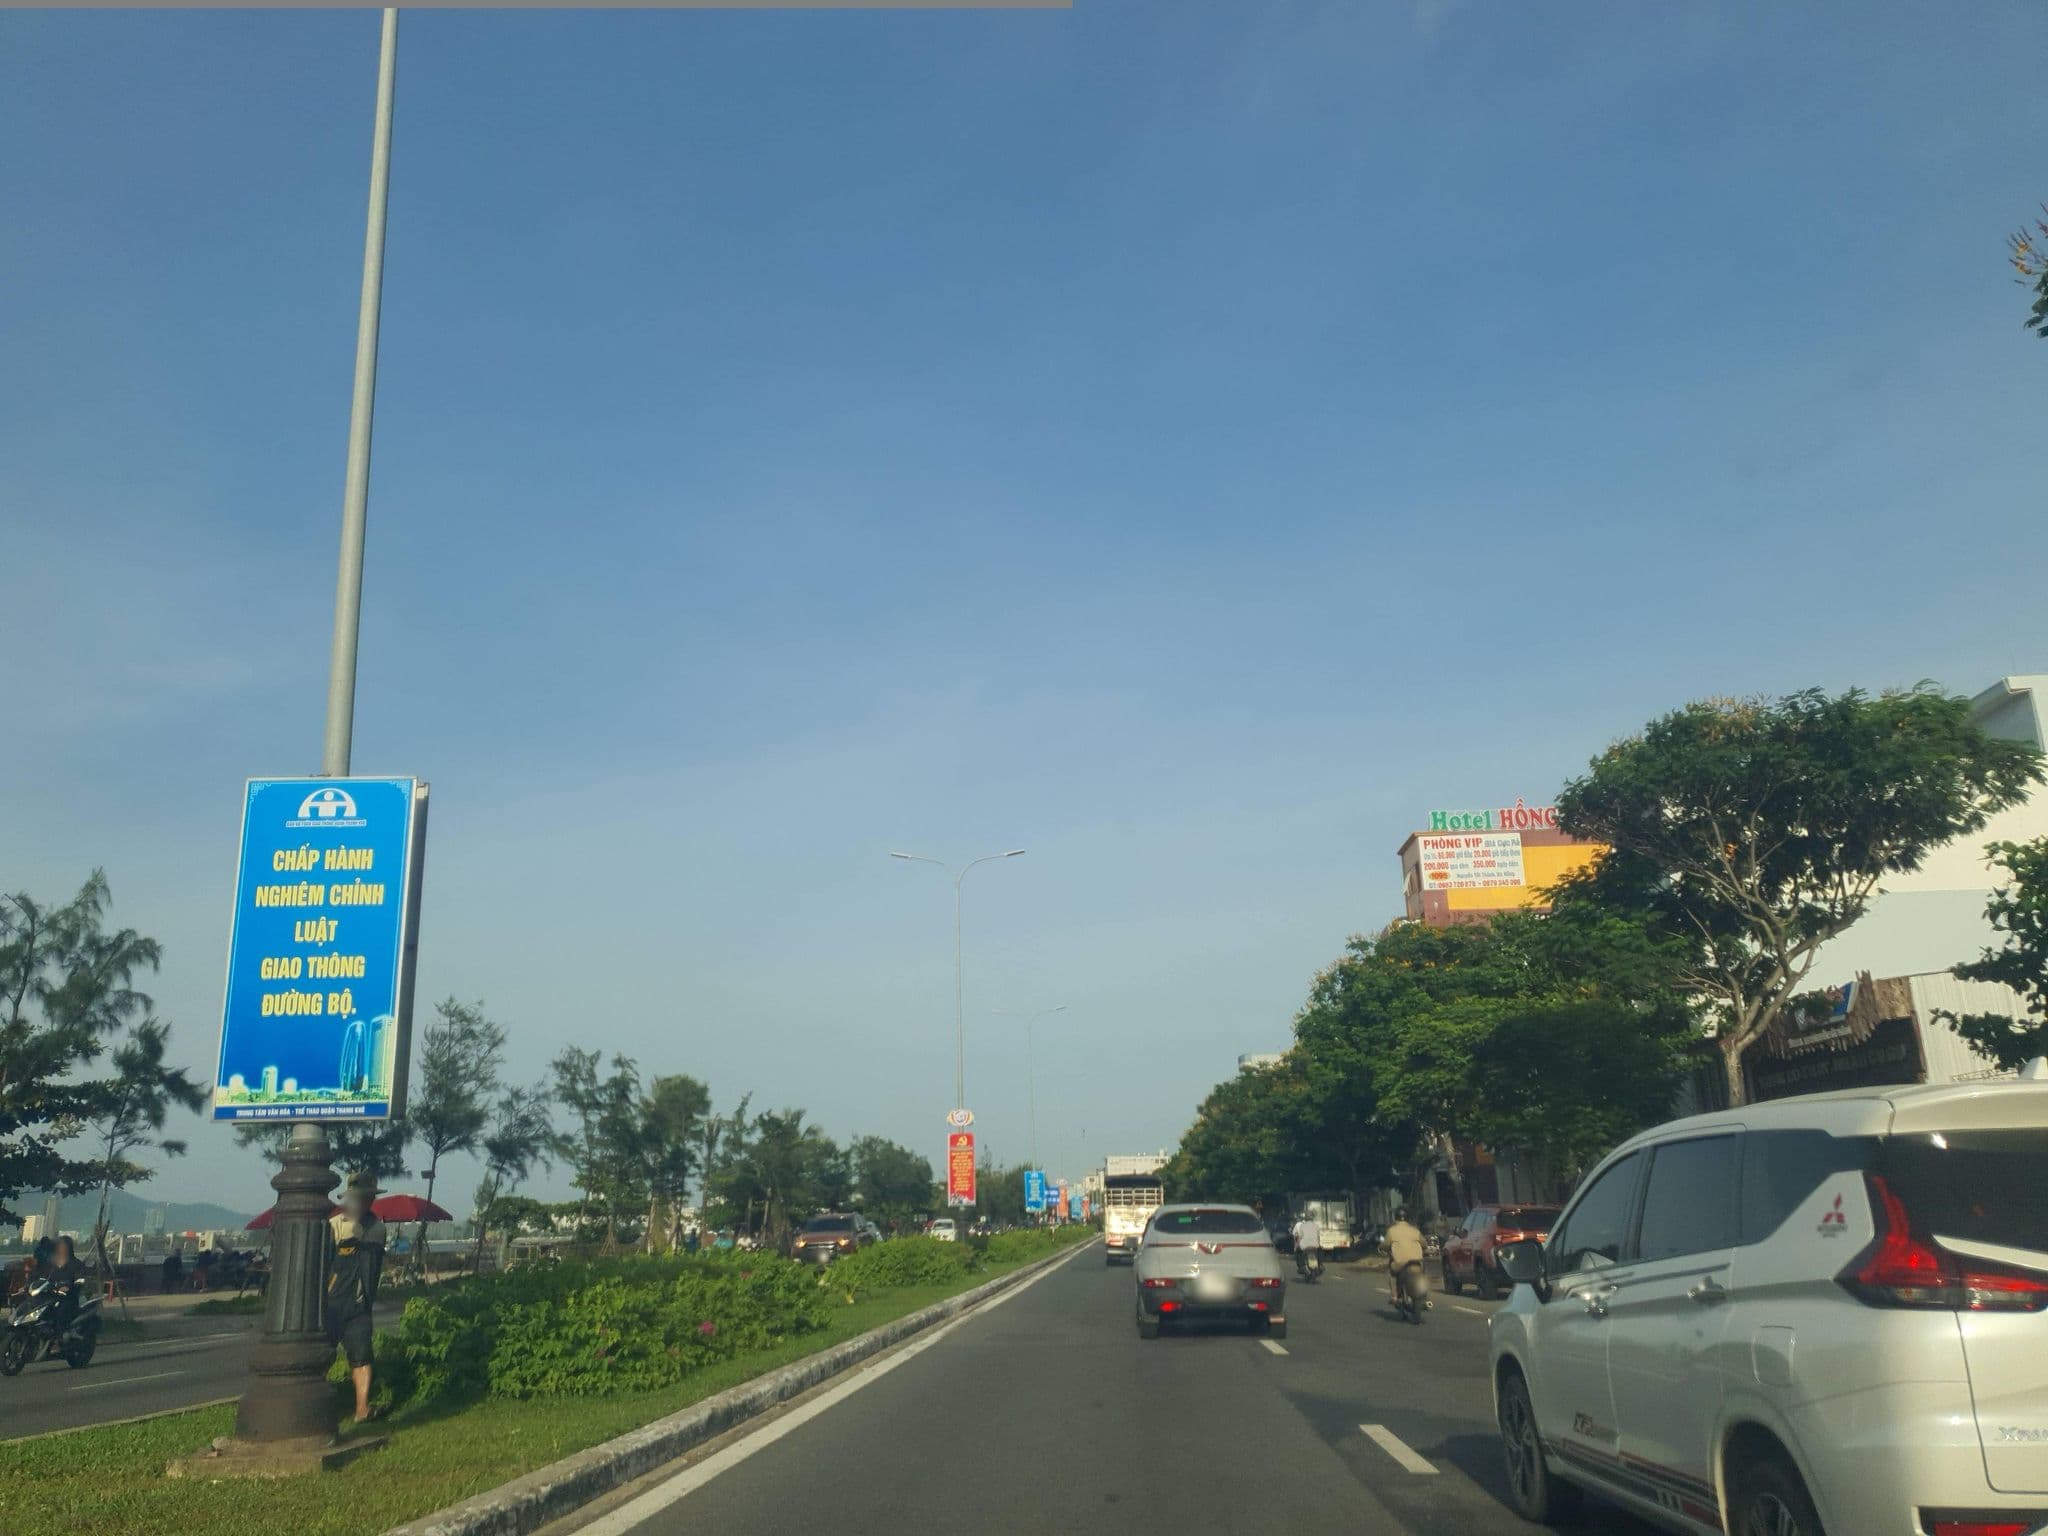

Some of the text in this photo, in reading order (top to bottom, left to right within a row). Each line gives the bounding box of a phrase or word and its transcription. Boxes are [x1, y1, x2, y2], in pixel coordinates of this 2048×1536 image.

[1431, 810, 1492, 830] Hotel
[272, 842, 374, 872] CHẤP HÀNH
[1423, 837, 1461, 849] PHÒNG
[1464, 837, 1483, 848] VIP
[255, 877, 385, 907] NGHIÊM CHỈNH
[294, 916, 339, 947] LUẬT
[260, 952, 366, 980] GIAO THÔNG
[261, 988, 357, 1019] ĐƯỜNG BỘ.
